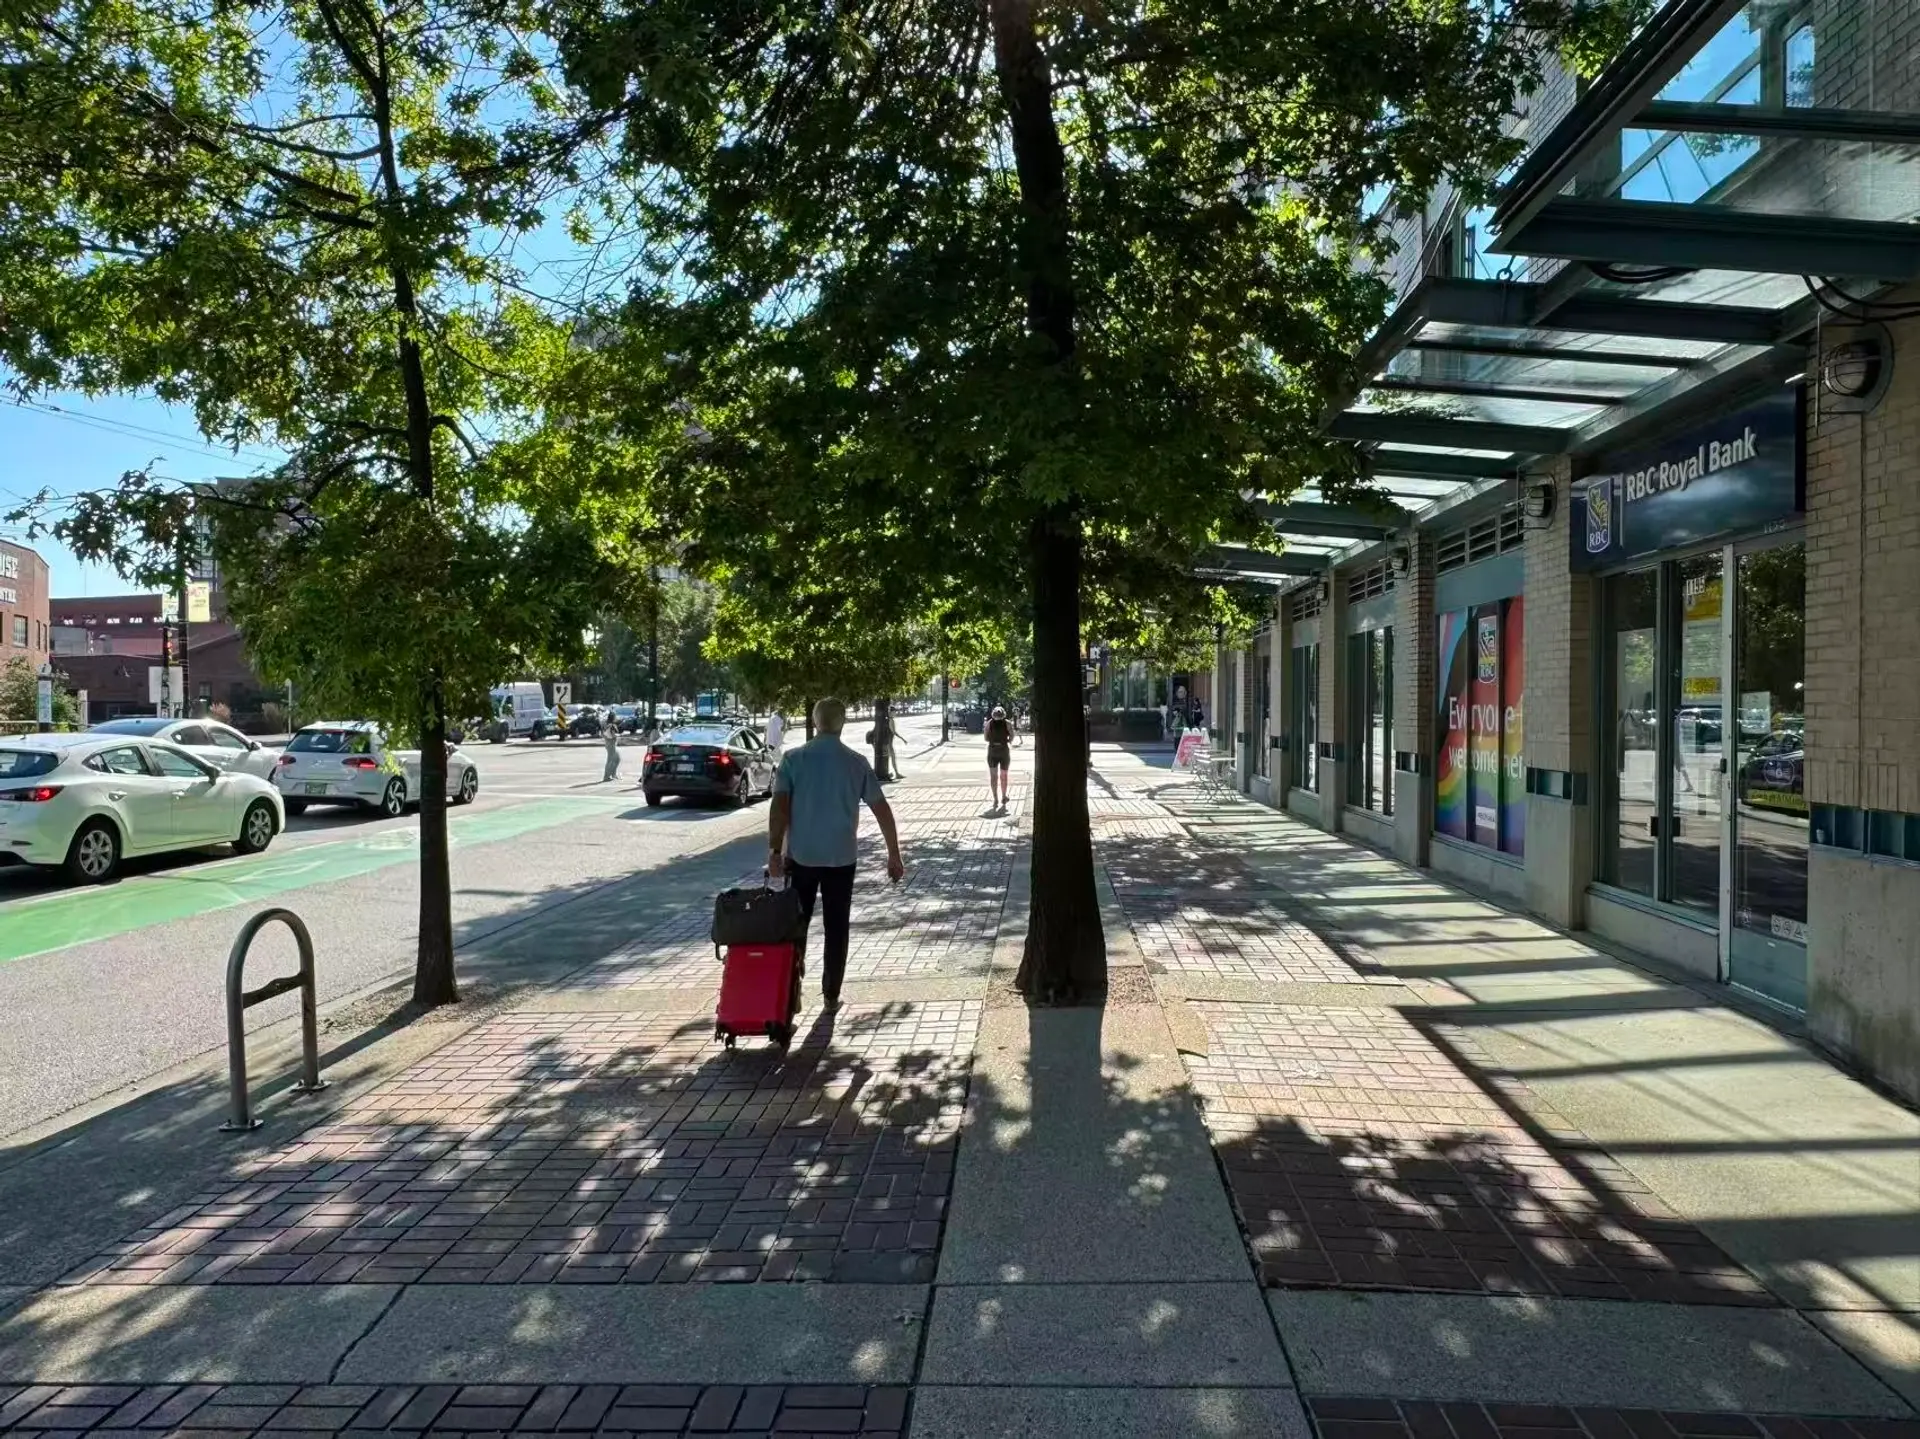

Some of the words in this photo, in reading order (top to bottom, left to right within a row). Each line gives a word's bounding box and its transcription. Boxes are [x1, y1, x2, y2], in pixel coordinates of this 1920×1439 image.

[1626, 466, 1657, 502] RBC
[1659, 445, 1705, 491] Royal
[1709, 426, 1756, 473] Bank
[1589, 529, 1608, 548] RBC
